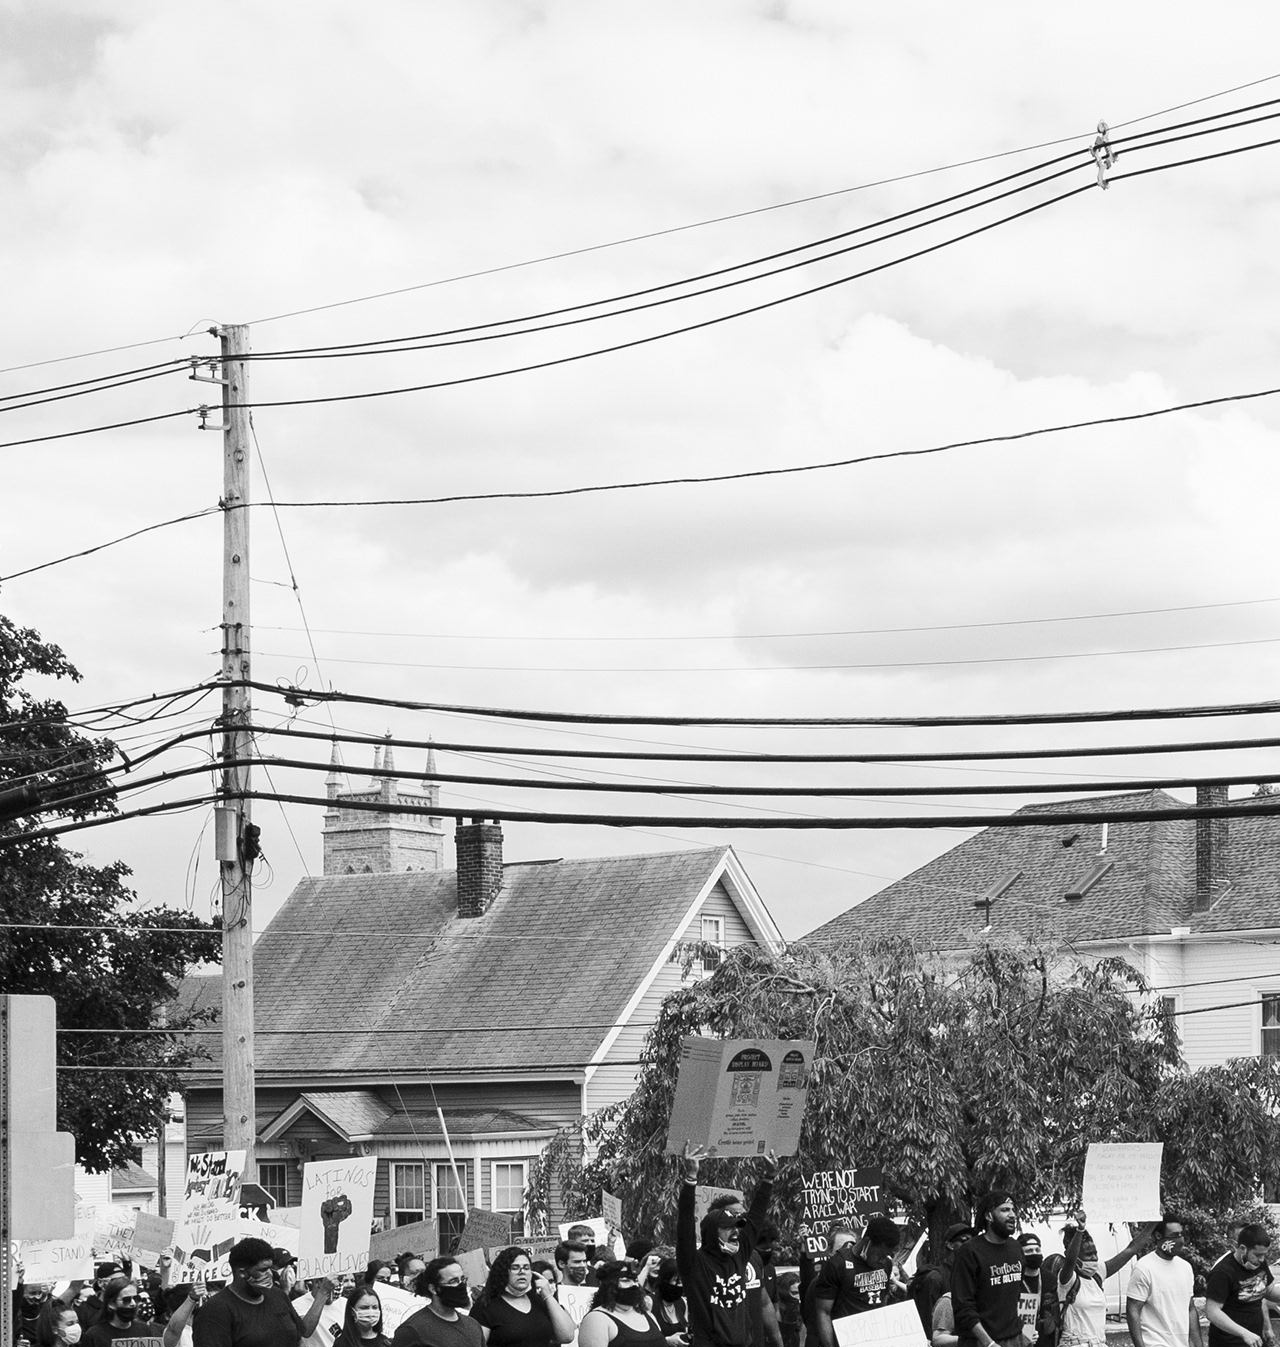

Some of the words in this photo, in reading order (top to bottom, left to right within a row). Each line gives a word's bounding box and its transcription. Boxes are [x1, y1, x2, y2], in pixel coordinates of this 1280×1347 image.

[306, 1165, 375, 1190] LATINOS
[801, 1171, 836, 1189] WERE
[835, 1169, 858, 1188] NOT
[834, 1187, 848, 1203] TO
[848, 1186, 880, 1202] START
[803, 1206, 812, 1219] A
[812, 1203, 836, 1219] RACE
[835, 1201, 858, 1214] WAR
[807, 1235, 828, 1253] END
[29, 1249, 42, 1265] I
[51, 1246, 85, 1264] STAND
[181, 1267, 218, 1283] PEACE
[297, 1254, 337, 1279] BLACK
[860, 1282, 887, 1293] BASEBALL
[990, 1276, 1001, 1286] THE
